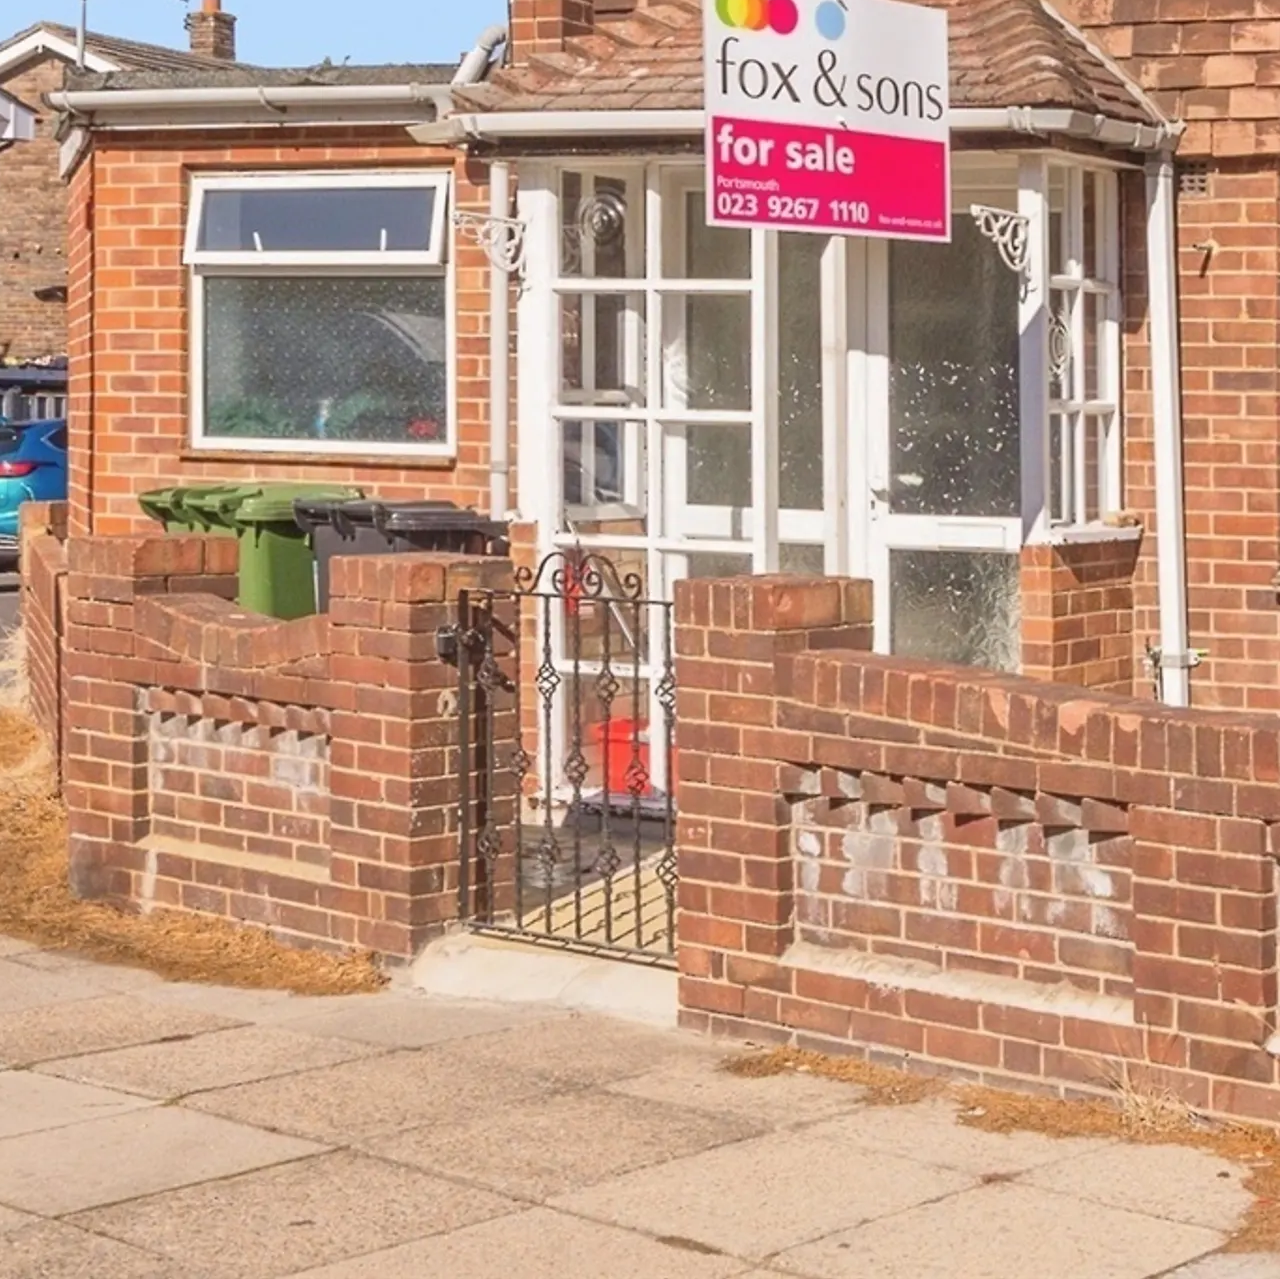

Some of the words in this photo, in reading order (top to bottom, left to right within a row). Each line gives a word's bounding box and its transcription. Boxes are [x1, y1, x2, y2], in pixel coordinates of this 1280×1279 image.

[715, 36, 801, 104] fox
[813, 49, 848, 108] &
[857, 73, 944, 121] sons
[716, 123, 775, 167] for
[785, 134, 856, 175] sale
[716, 175, 780, 192] Portsmouth
[717, 192, 759, 218] 023
[767, 197, 820, 221] 9267
[828, 200, 870, 225] 1110
